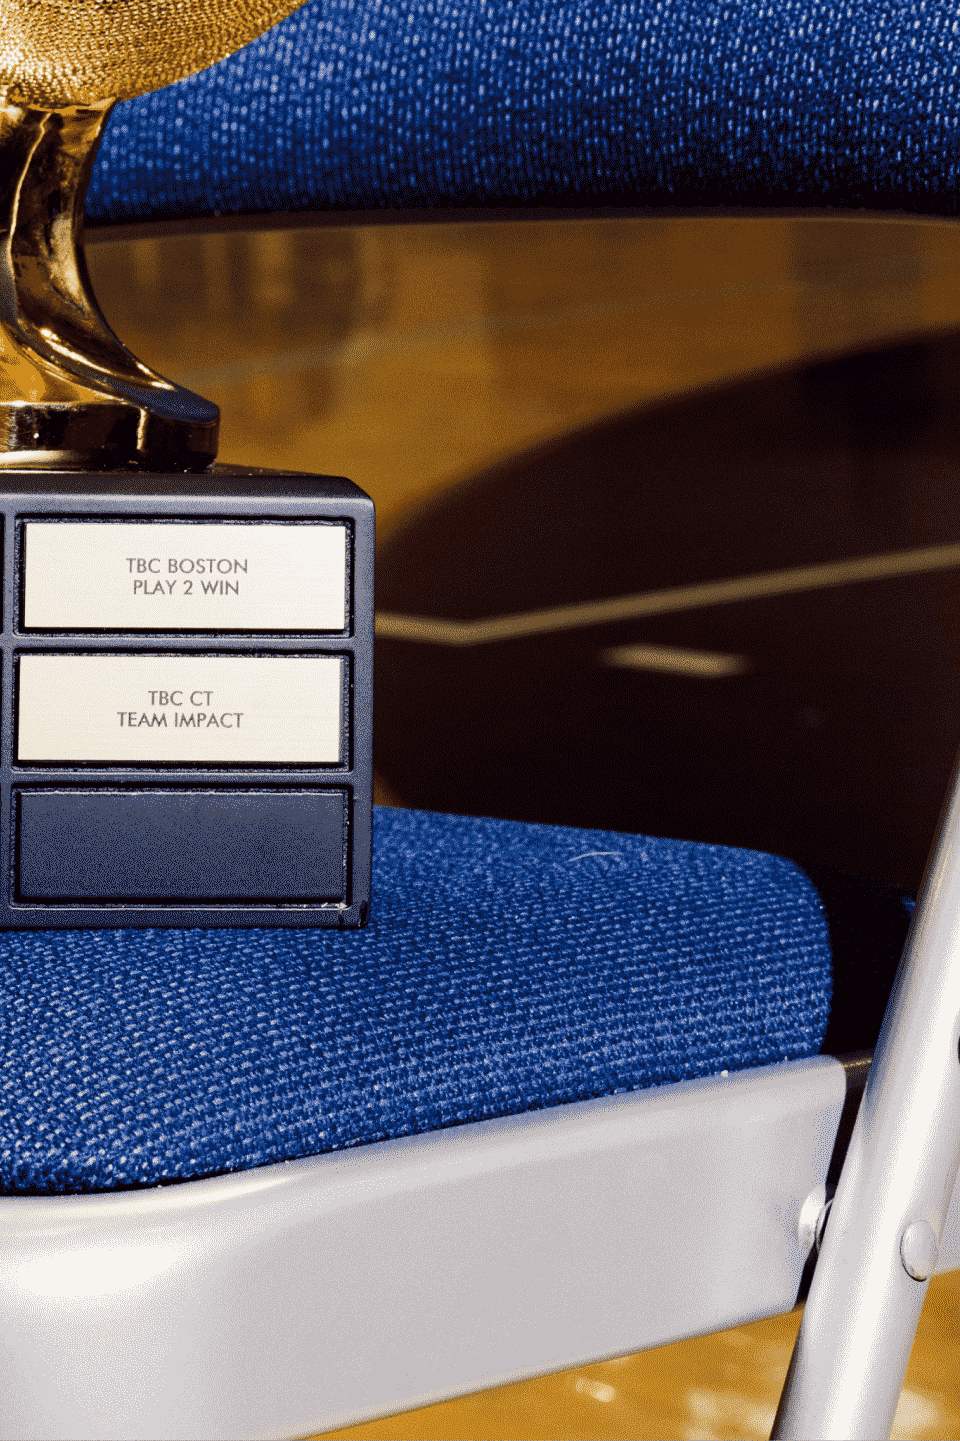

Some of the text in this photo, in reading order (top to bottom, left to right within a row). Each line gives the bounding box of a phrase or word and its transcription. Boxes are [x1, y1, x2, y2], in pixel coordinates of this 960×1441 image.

[125, 557, 248, 575] TBC BOSTON
[133, 579, 239, 596] PLAY 2 WIN
[147, 690, 214, 707] TBC CT
[116, 711, 244, 729] TEAM IMPACT
